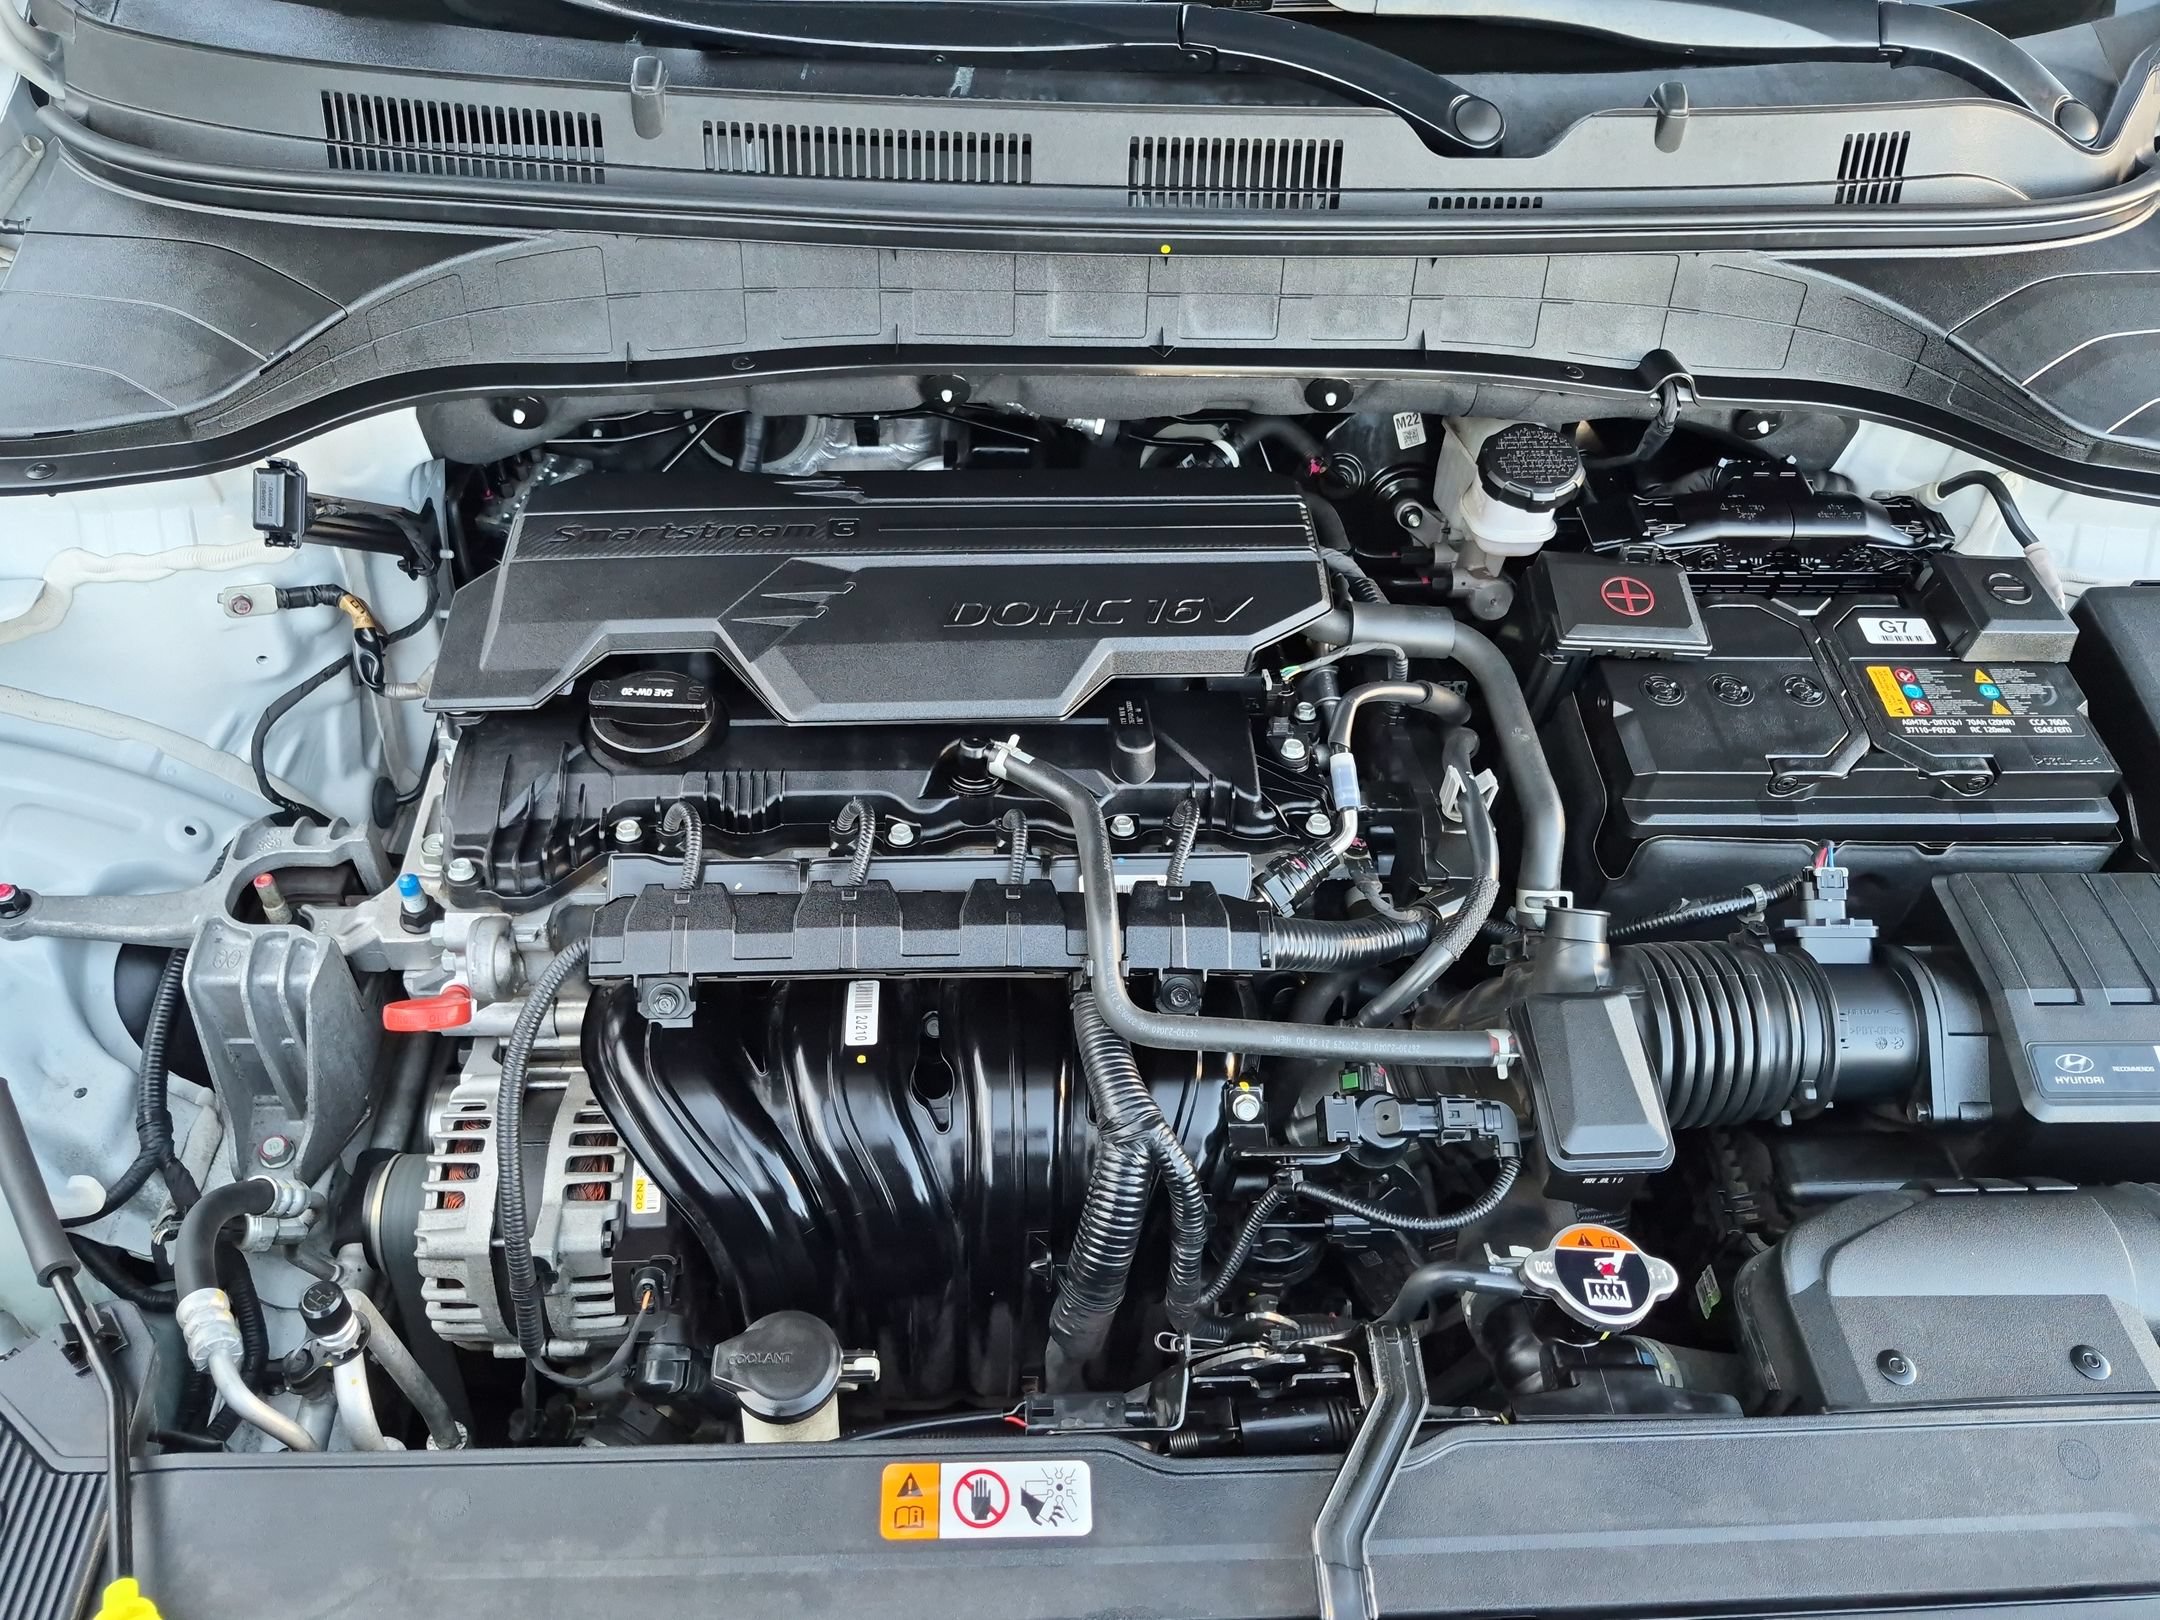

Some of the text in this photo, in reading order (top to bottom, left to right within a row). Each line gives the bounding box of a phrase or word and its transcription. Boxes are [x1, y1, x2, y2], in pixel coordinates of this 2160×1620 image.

[1396, 412, 1420, 430] M22
[549, 521, 817, 544] Smartstream
[943, 596, 1254, 628] DOHC 16V
[1879, 620, 1908, 634] G7
[621, 687, 675, 697] SAE 0W-20
[855, 1015, 868, 1041] 2J210
[2055, 1076, 2105, 1085] HYUNDAI
[728, 1352, 793, 1366] COOLANT
